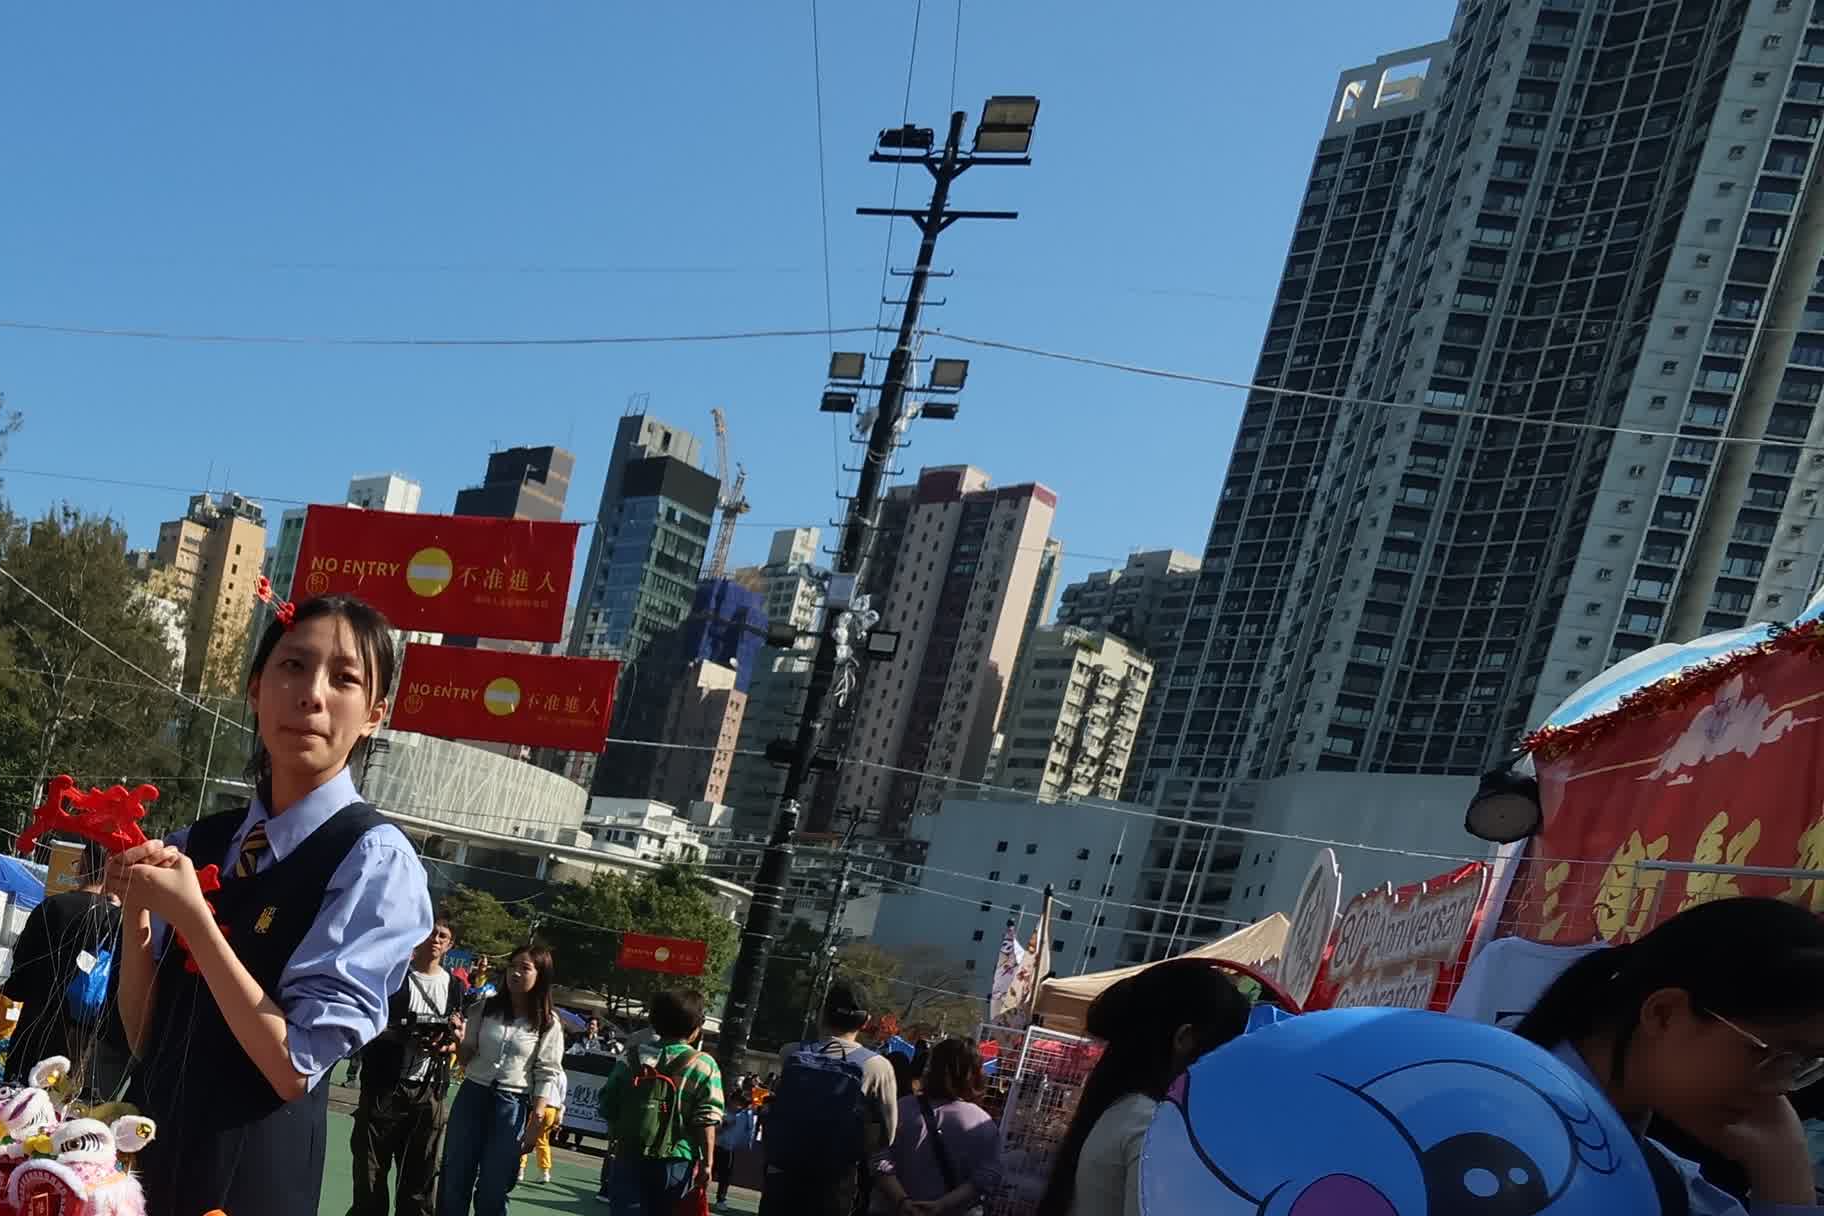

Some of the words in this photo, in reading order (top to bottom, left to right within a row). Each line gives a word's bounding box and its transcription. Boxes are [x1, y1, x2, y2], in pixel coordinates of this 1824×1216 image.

[310, 555, 338, 573] NO
[342, 559, 401, 578] ENTRY
[408, 681, 431, 696] NO
[433, 685, 480, 701] ENTRY
